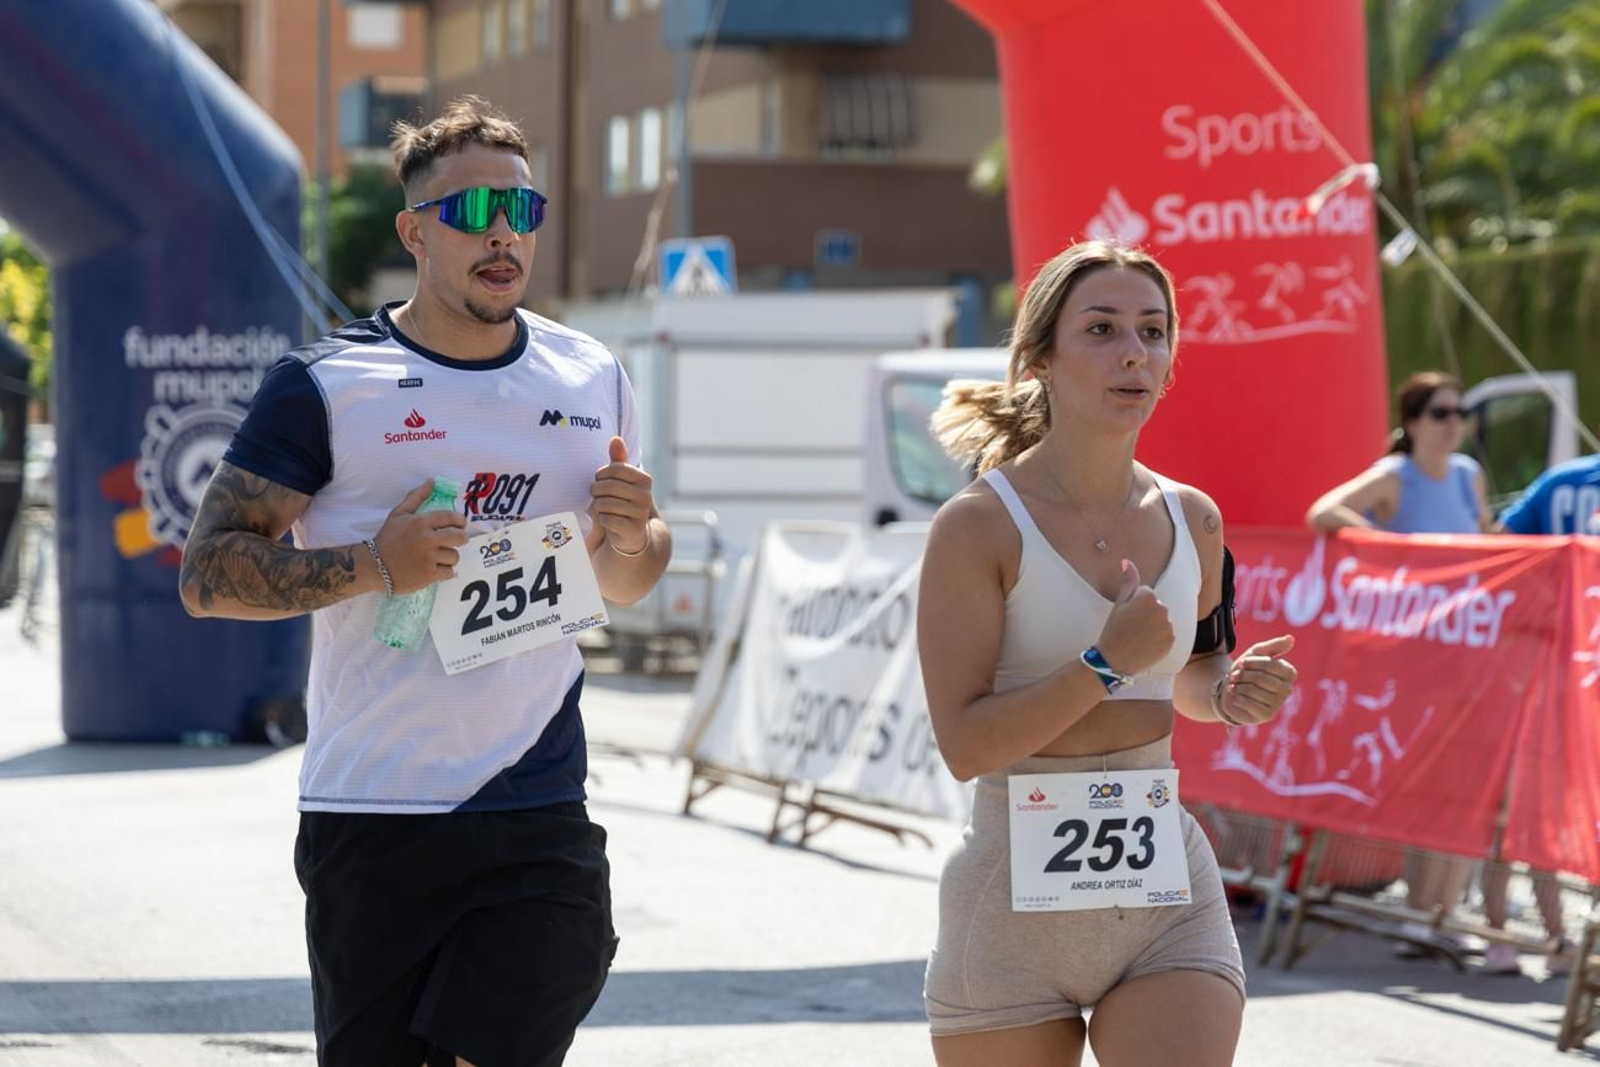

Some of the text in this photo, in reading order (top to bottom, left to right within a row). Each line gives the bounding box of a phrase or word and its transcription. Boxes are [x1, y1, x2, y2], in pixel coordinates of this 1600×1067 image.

[1161, 104, 1322, 168] Sports
[123, 326, 291, 367] fundación
[384, 429, 447, 444] Santander
[570, 415, 602, 431] mupol
[460, 555, 562, 636] 254
[1320, 556, 1516, 648] Santander
[506, 621, 536, 638] MARTOS
[536, 613, 562, 629] RINCÓN
[1016, 803, 1058, 812] Santander
[1043, 816, 1155, 873] 253
[1070, 877, 1143, 890] ANDREA ORTIZ DÍAZ
